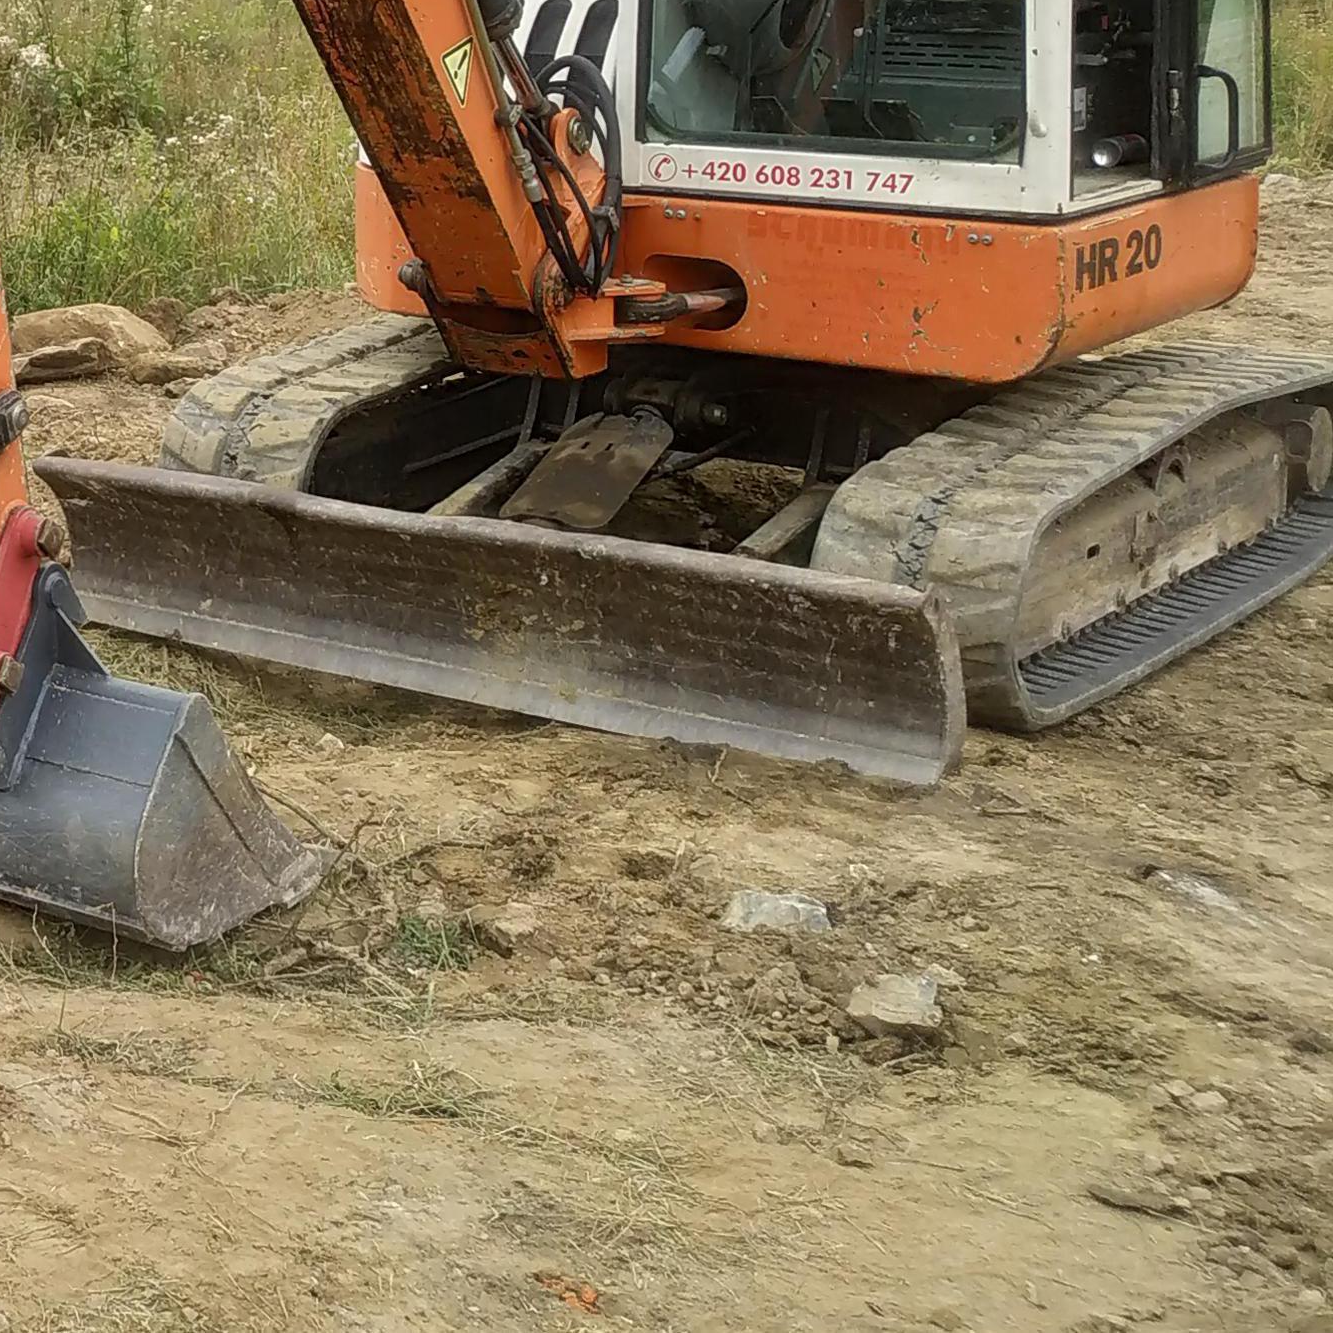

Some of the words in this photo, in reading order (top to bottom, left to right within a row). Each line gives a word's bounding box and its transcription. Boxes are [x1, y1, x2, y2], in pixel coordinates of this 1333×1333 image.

[681, 160, 747, 183] +420
[755, 165, 801, 187] 608
[810, 168, 853, 190] 231
[865, 171, 915, 194] 747
[1073, 236, 1119, 294] HR
[1125, 223, 1163, 279] 20
